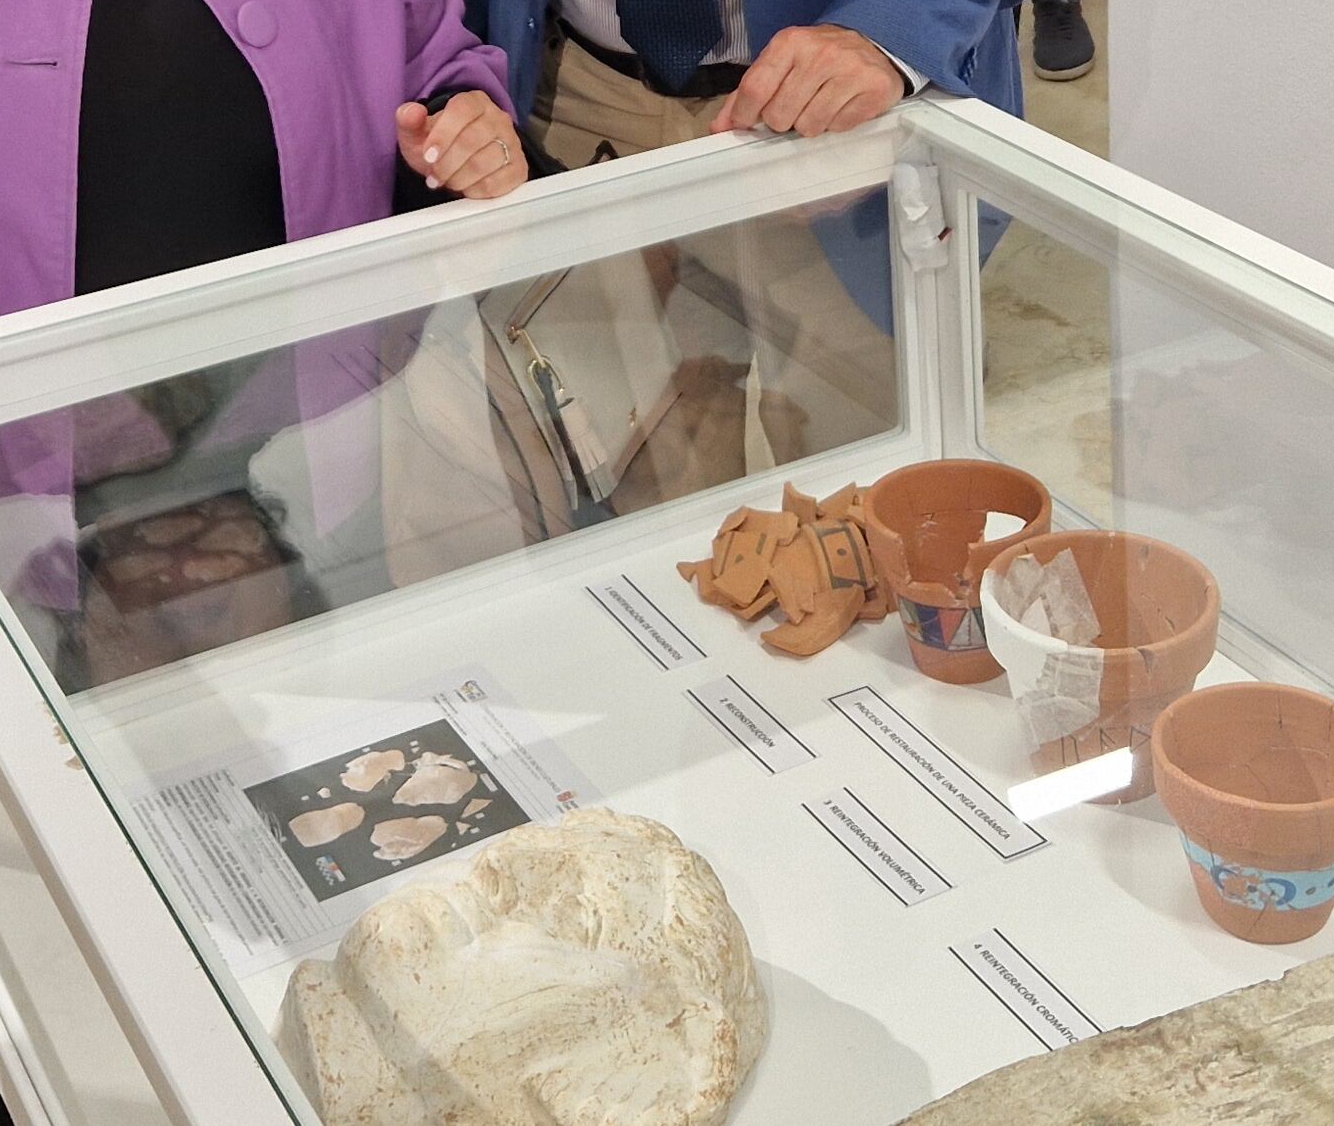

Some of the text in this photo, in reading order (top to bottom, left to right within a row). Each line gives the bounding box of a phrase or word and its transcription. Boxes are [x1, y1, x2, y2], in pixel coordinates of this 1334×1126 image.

[854, 701, 1011, 840] PROCESO DE RESTAURACIÓN DE UNA PIEZA CERÁMICA
[829, 804, 881, 853] REINTEGRACIÓN
[877, 850, 926, 895] VOLUMÉTRICA
[980, 949, 1040, 1007] REINTEGRACIÓN
[1035, 1004, 1079, 1045] CROMÁTIC
